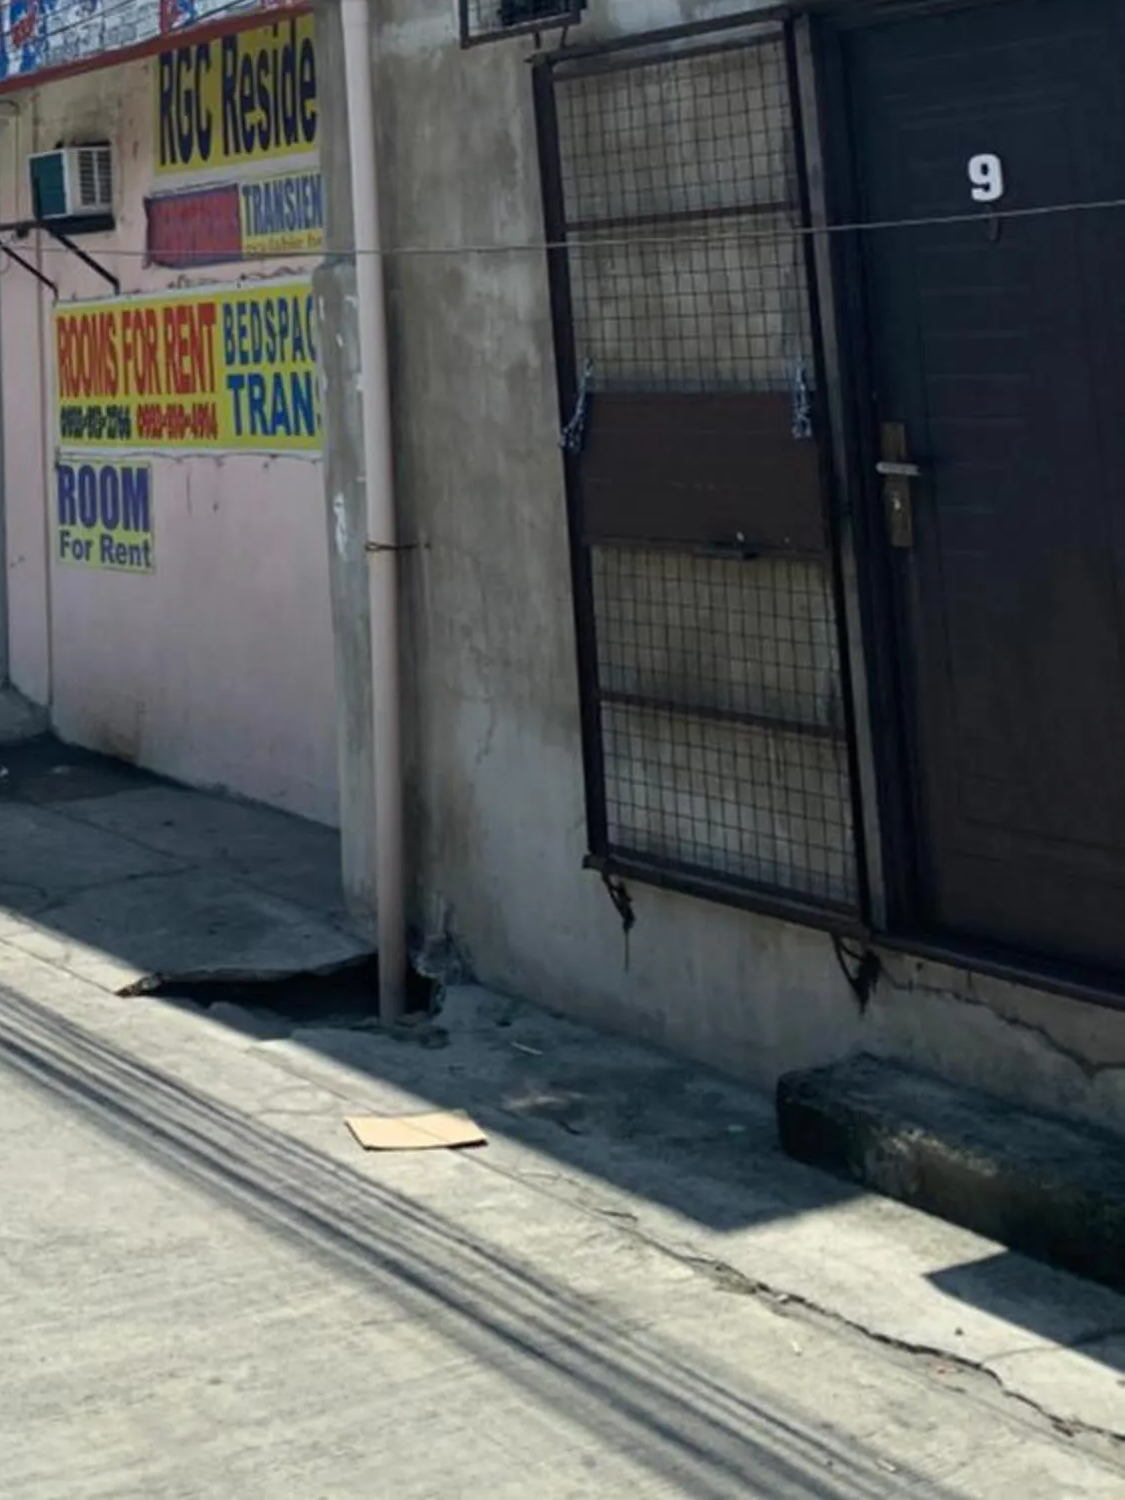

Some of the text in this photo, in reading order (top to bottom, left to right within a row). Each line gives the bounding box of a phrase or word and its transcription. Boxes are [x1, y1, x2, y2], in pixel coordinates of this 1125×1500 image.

[159, 16, 317, 166] RGC Reside
[968, 153, 1003, 202] 9
[56, 301, 217, 398] ROOMS FOR RENT
[57, 464, 150, 533] ROOM
[59, 531, 152, 567] For Rent
